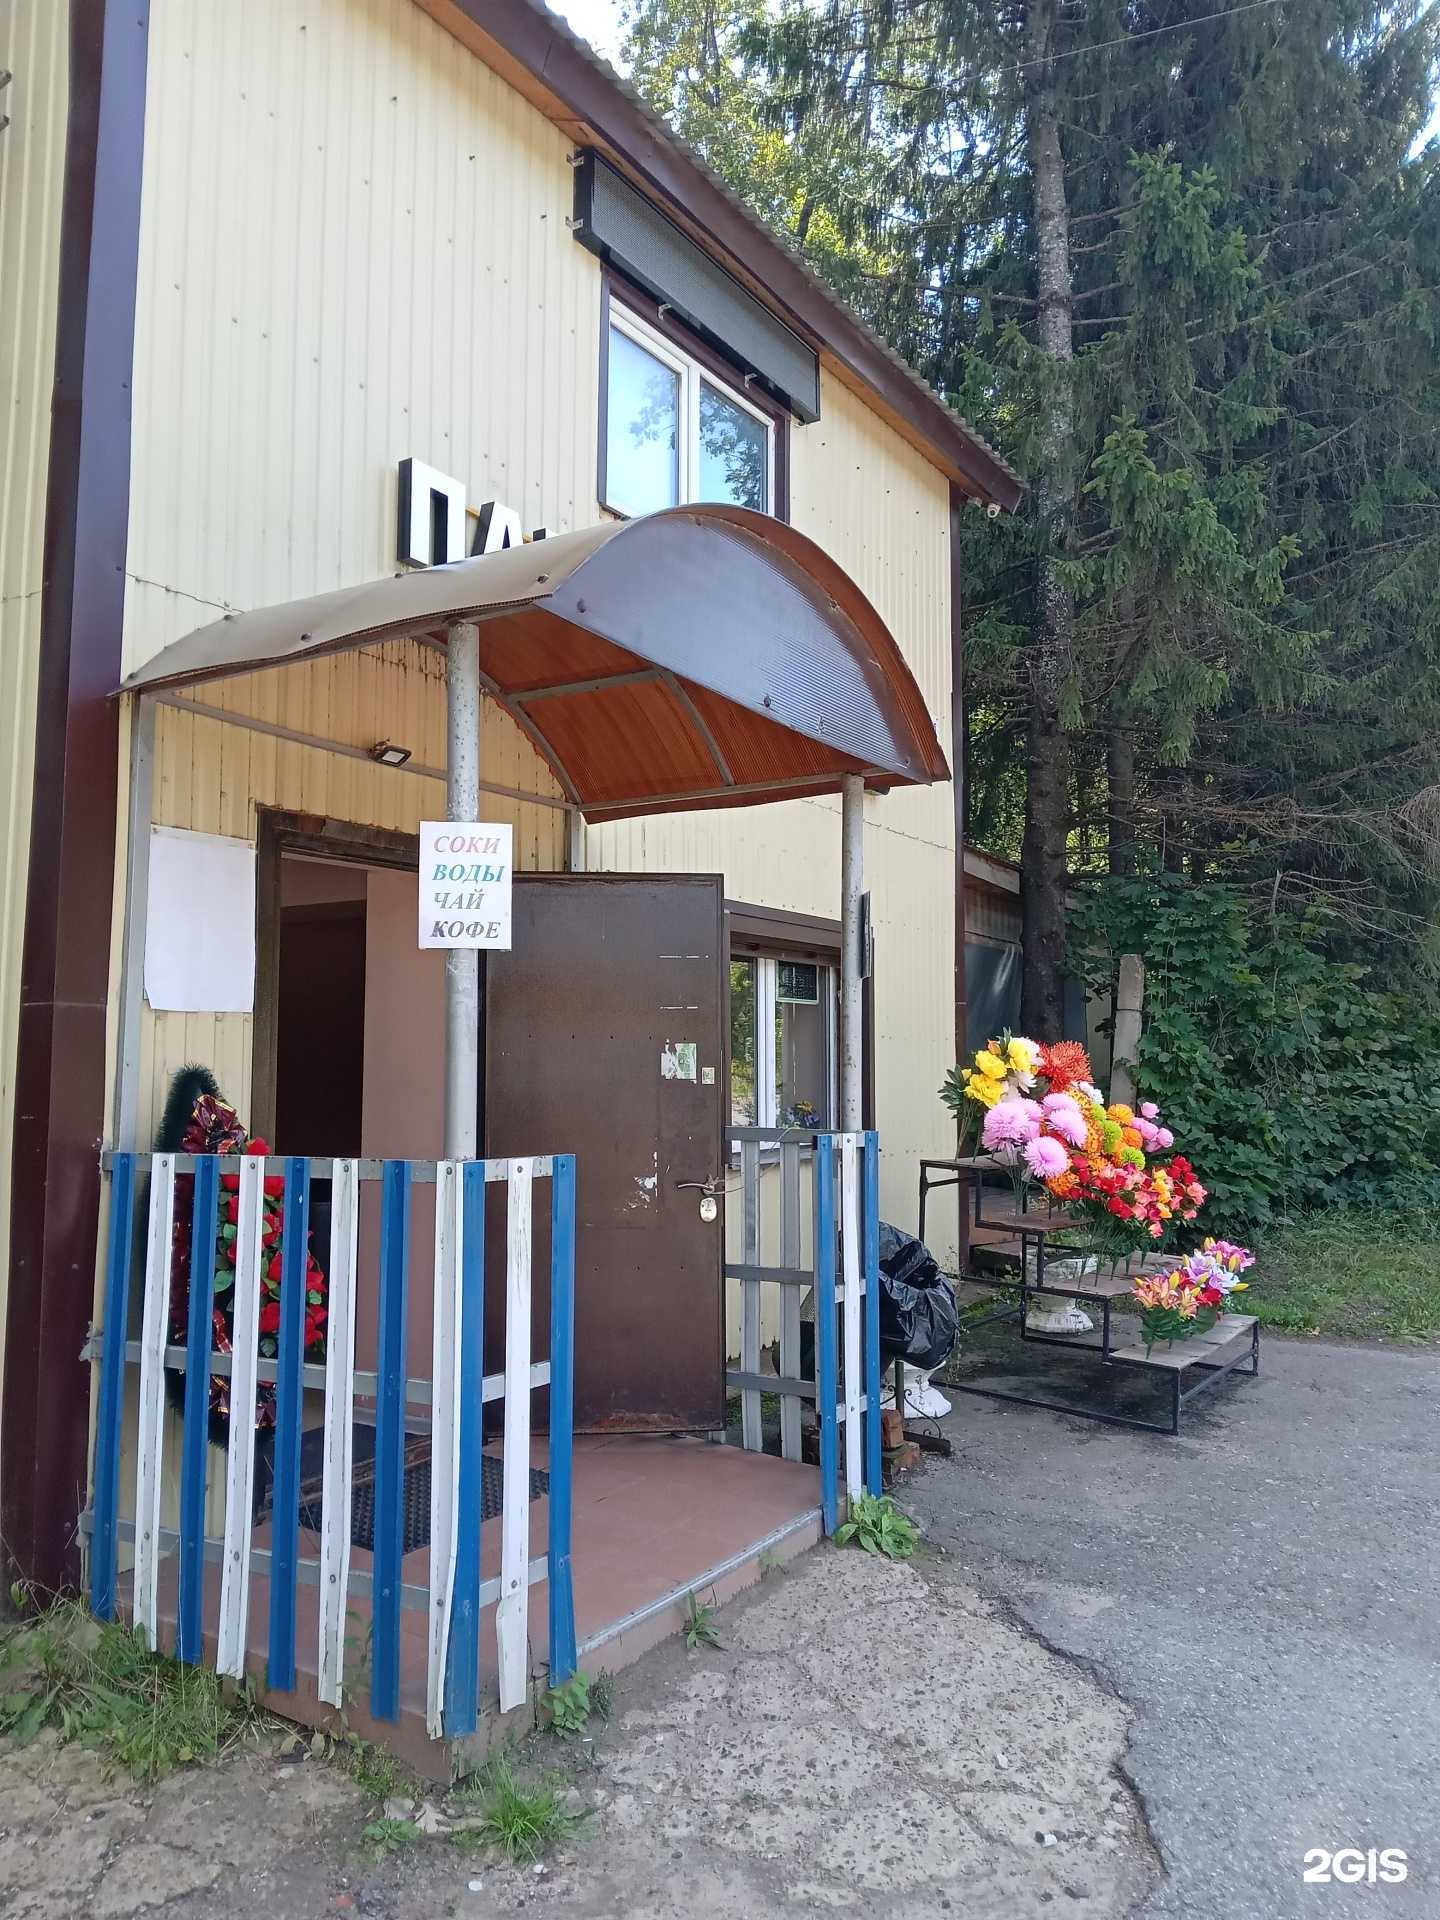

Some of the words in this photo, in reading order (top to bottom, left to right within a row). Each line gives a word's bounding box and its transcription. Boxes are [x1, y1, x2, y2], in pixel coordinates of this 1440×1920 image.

[397, 457, 558, 569] ПА
[433, 836, 500, 854] СОКИ
[432, 864, 506, 884] ВОДЫ
[433, 889, 485, 909] ЧАЙ
[430, 921, 501, 939] КОФЕ
